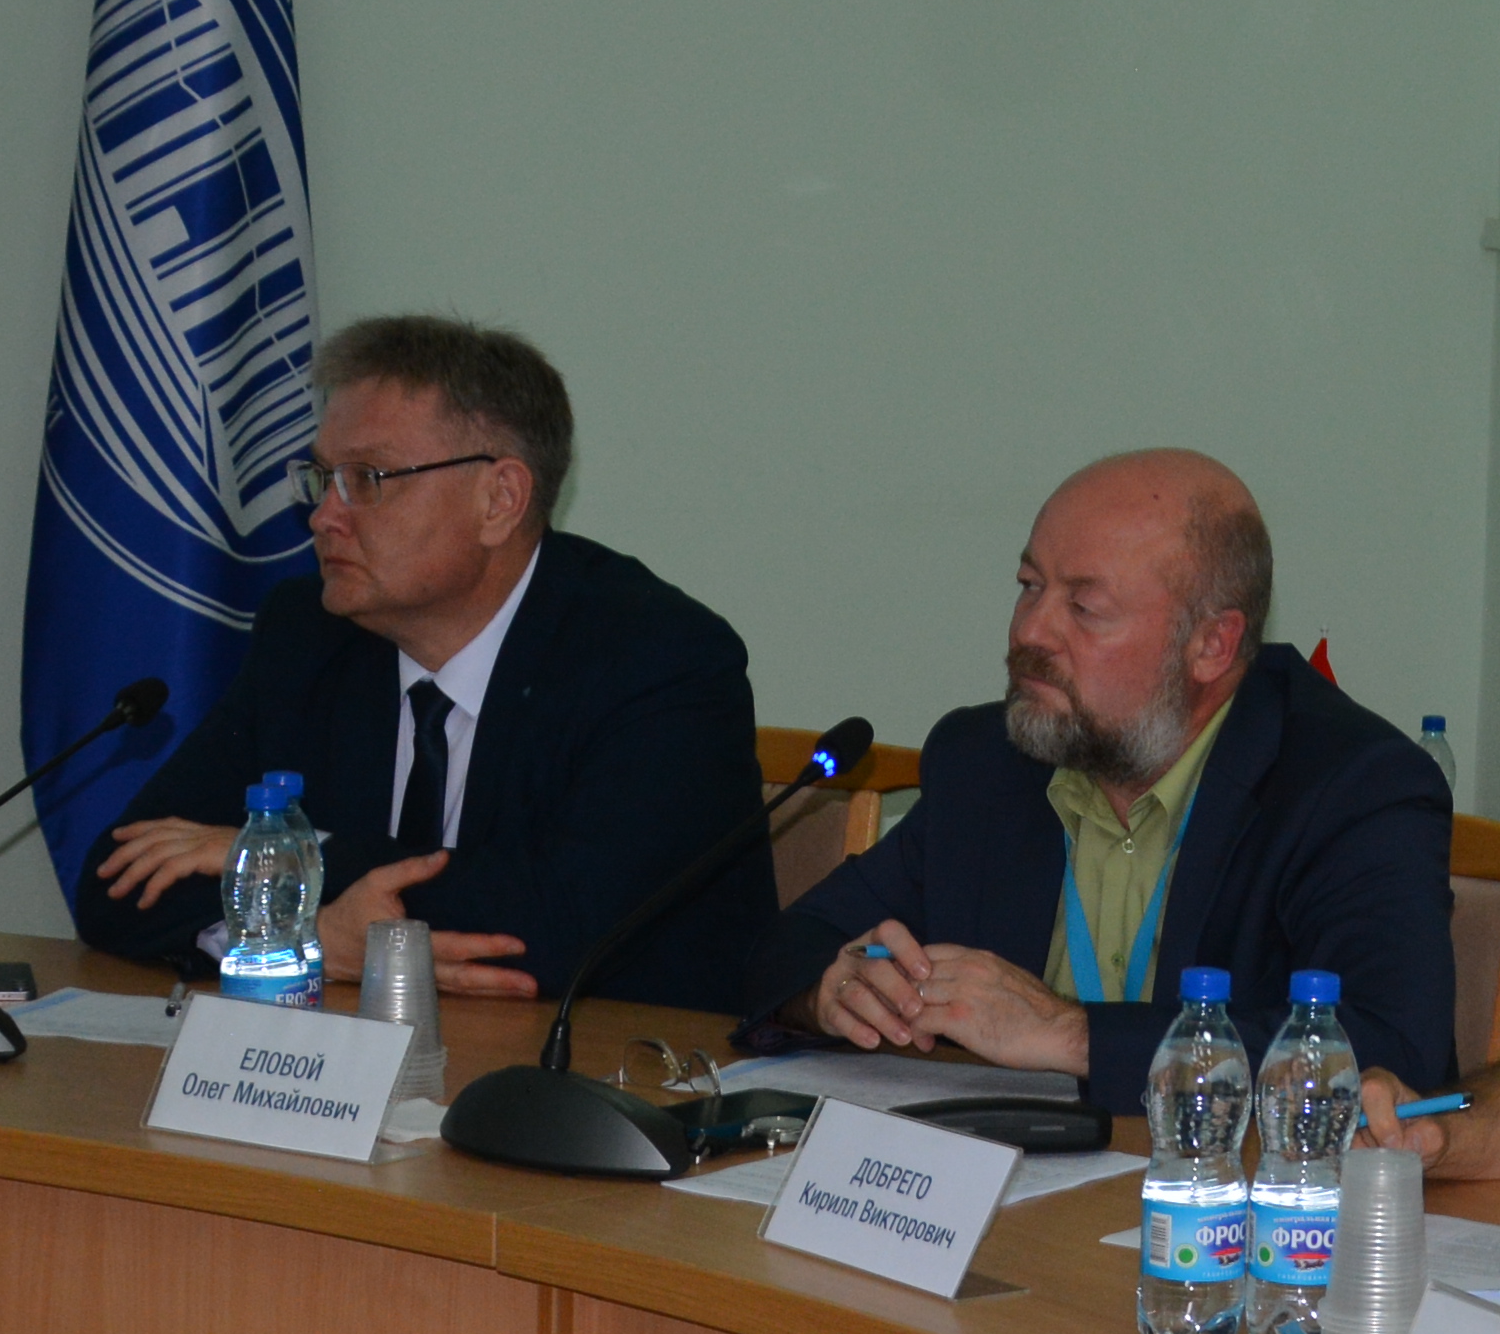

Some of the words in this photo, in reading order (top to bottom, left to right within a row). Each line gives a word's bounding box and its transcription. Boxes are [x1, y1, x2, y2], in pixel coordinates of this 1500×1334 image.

[239, 1047, 326, 1081] ЕЛОВОЙ
[181, 1072, 230, 1099] Олег
[232, 1080, 360, 1122] Михайлович
[850, 1157, 933, 1200] ДОБРЕГО
[799, 1180, 859, 1219] Кирилл
[858, 1198, 957, 1249] Викторович
